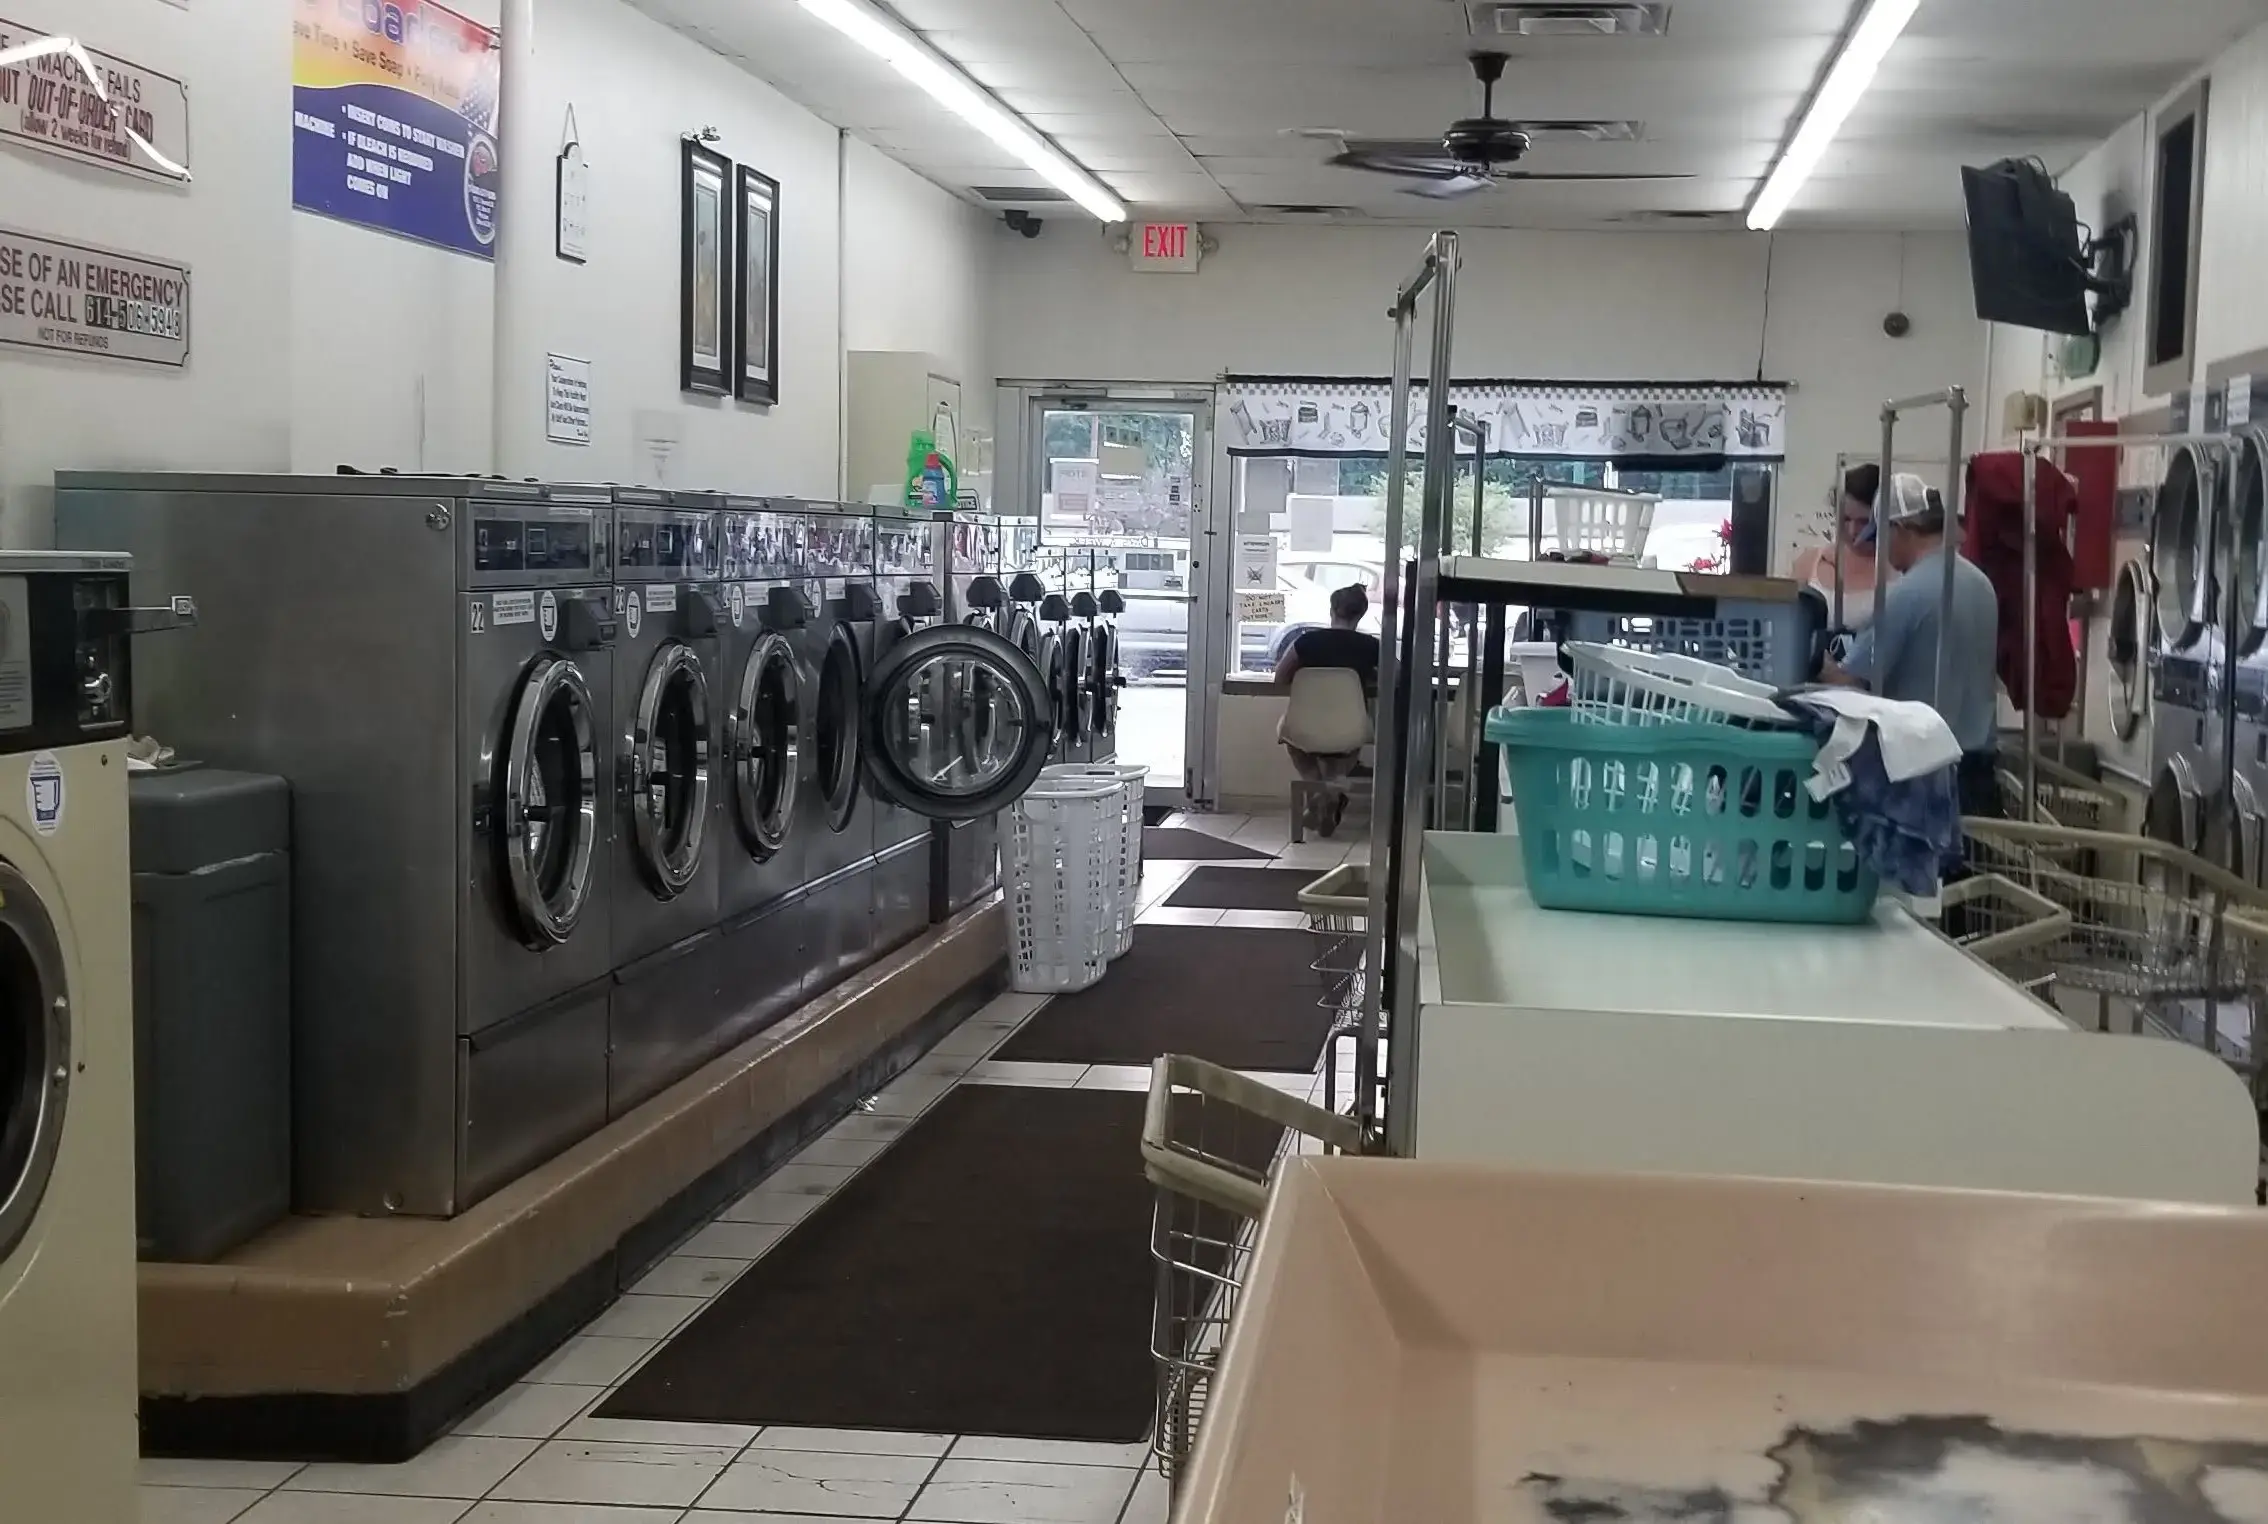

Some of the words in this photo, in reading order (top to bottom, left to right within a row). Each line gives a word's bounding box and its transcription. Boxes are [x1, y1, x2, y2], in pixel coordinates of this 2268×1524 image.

[352, 40, 376, 69] Save
[51, 118, 58, 138] 2
[1144, 225, 1188, 258] EXIT
[29, 252, 52, 283] OF
[56, 258, 80, 290] AN
[85, 263, 183, 308] EMERGENCY
[0, 283, 25, 316] SE
[31, 288, 78, 323] CALL
[38, 327, 54, 341] NOT
[56, 329, 73, 346] FOR
[74, 331, 109, 350] REFUNDS
[472, 603, 484, 632] 22
